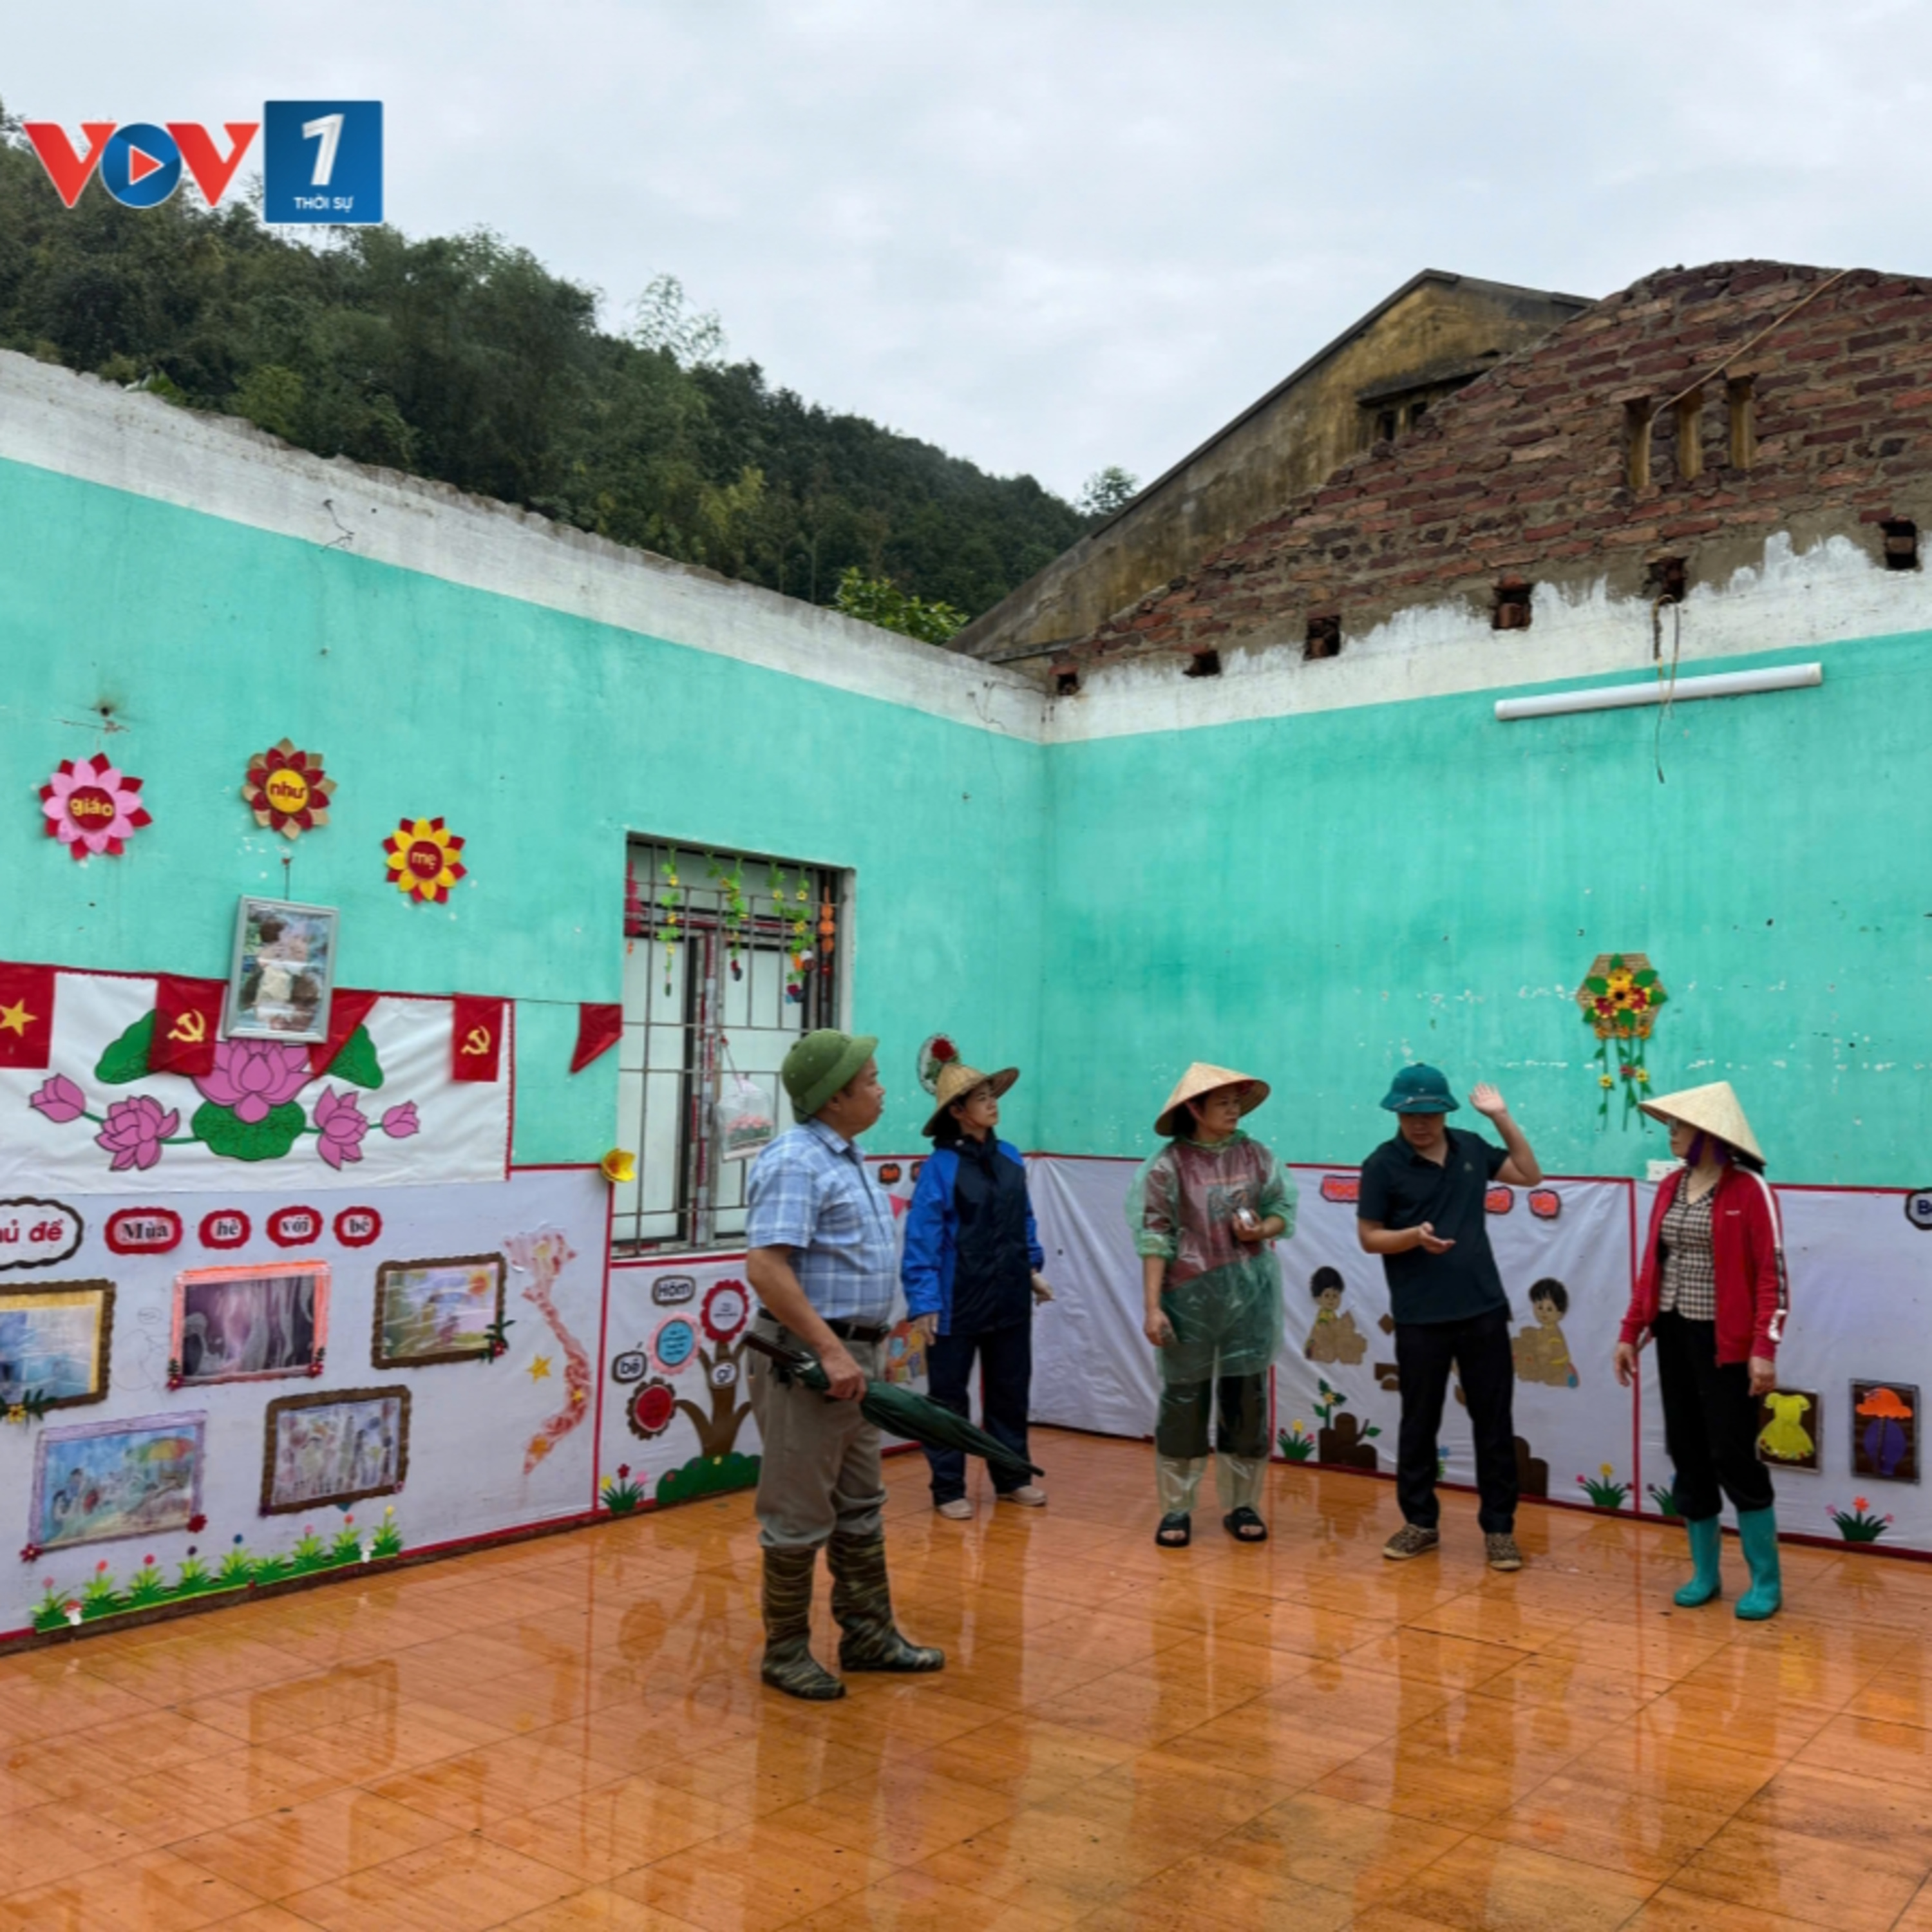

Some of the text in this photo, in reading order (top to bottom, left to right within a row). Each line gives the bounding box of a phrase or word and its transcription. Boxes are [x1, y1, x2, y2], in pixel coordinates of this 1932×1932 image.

[269, 781, 305, 800] như
[70, 797, 114, 817] giáo
[412, 851, 437, 870] mẹ
[0, 1218, 20, 1244] ủ
[122, 1221, 169, 1240] Mùa
[216, 1218, 239, 1236] hè
